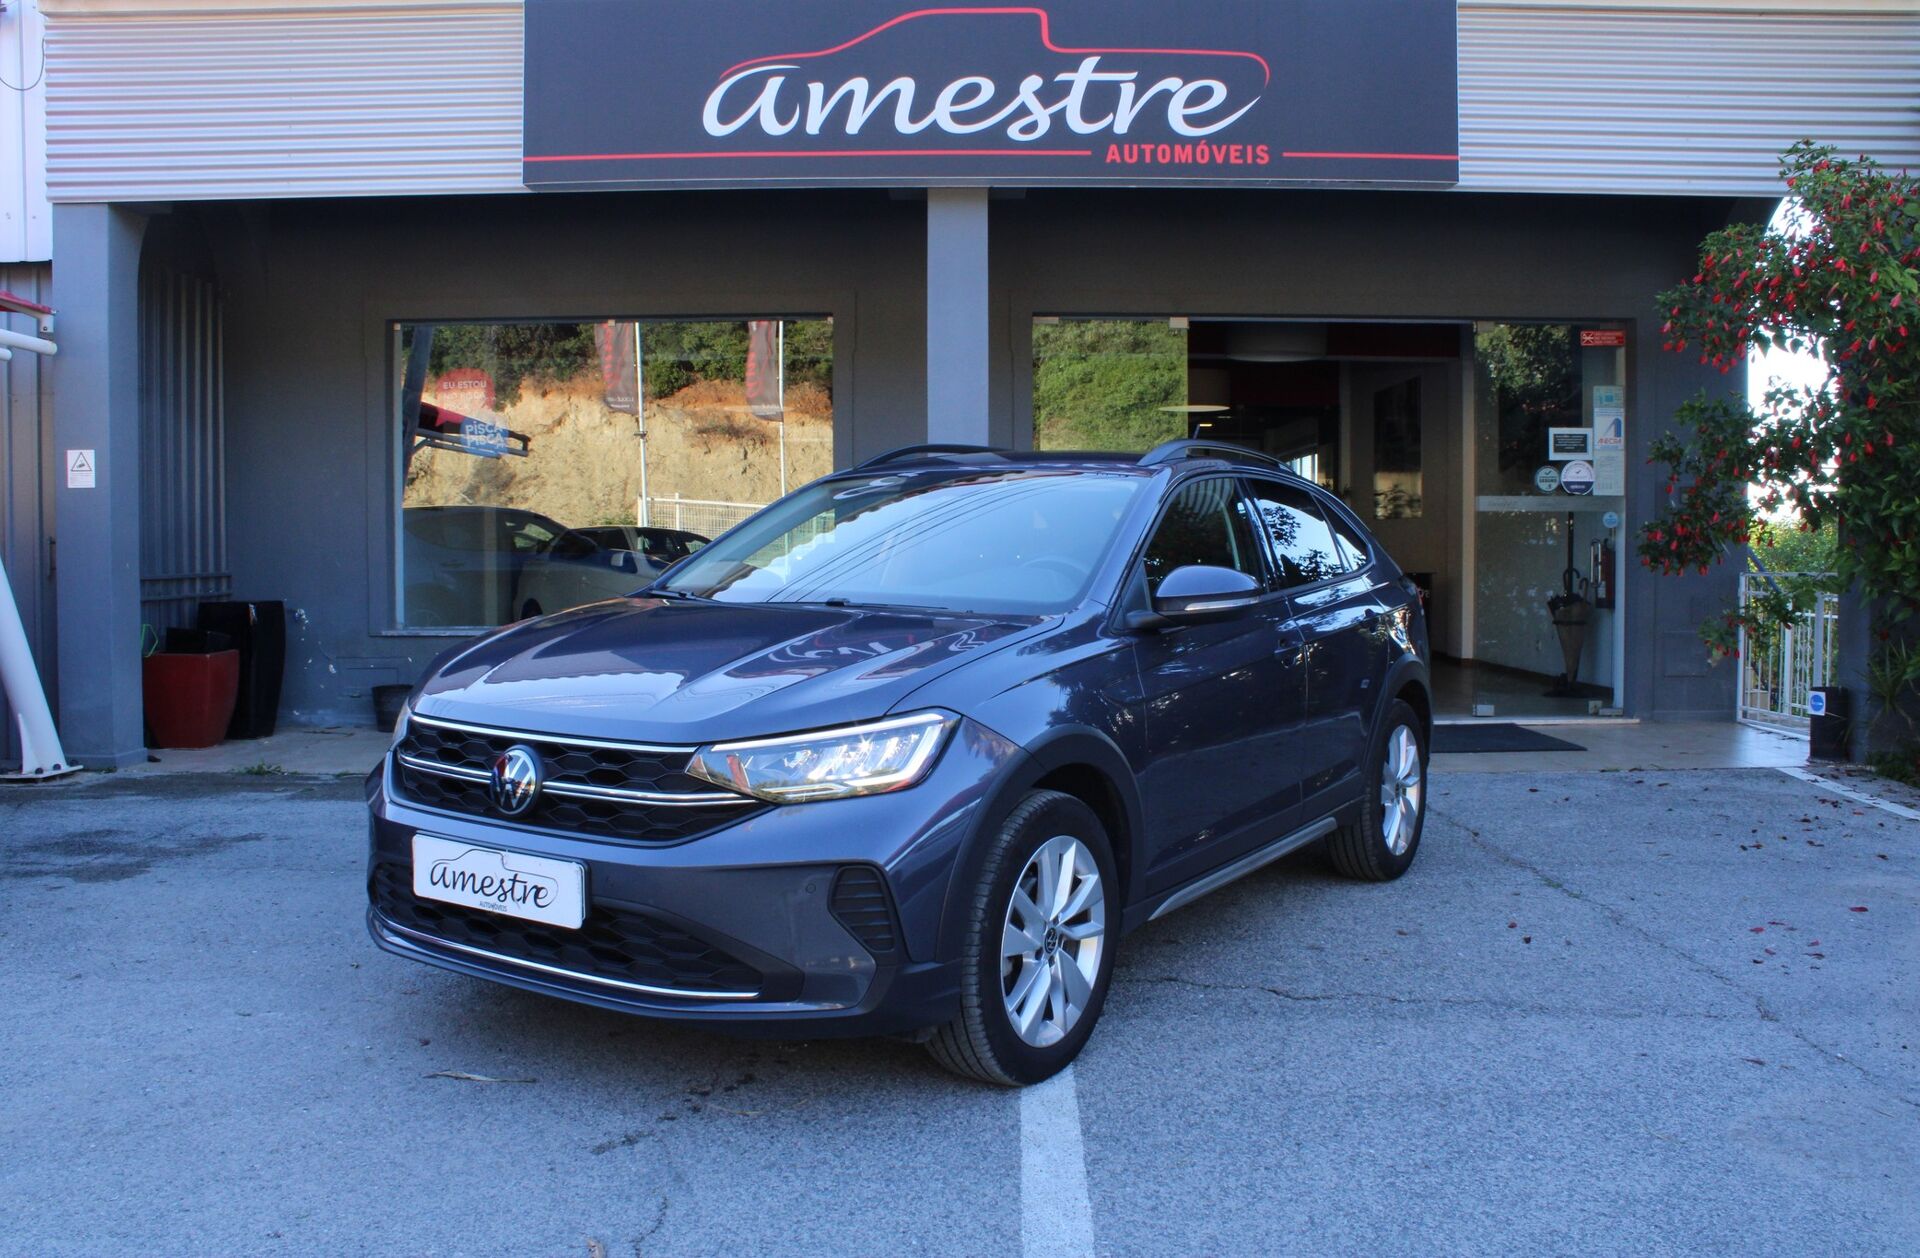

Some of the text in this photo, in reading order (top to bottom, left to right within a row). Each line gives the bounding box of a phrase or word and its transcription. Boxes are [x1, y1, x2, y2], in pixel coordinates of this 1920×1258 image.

[702, 56, 1261, 142] amestre
[1105, 140, 1271, 165] AUTOMÓVEIS
[442, 380, 487, 389] EU ESTOU
[430, 862, 554, 909] amestre
